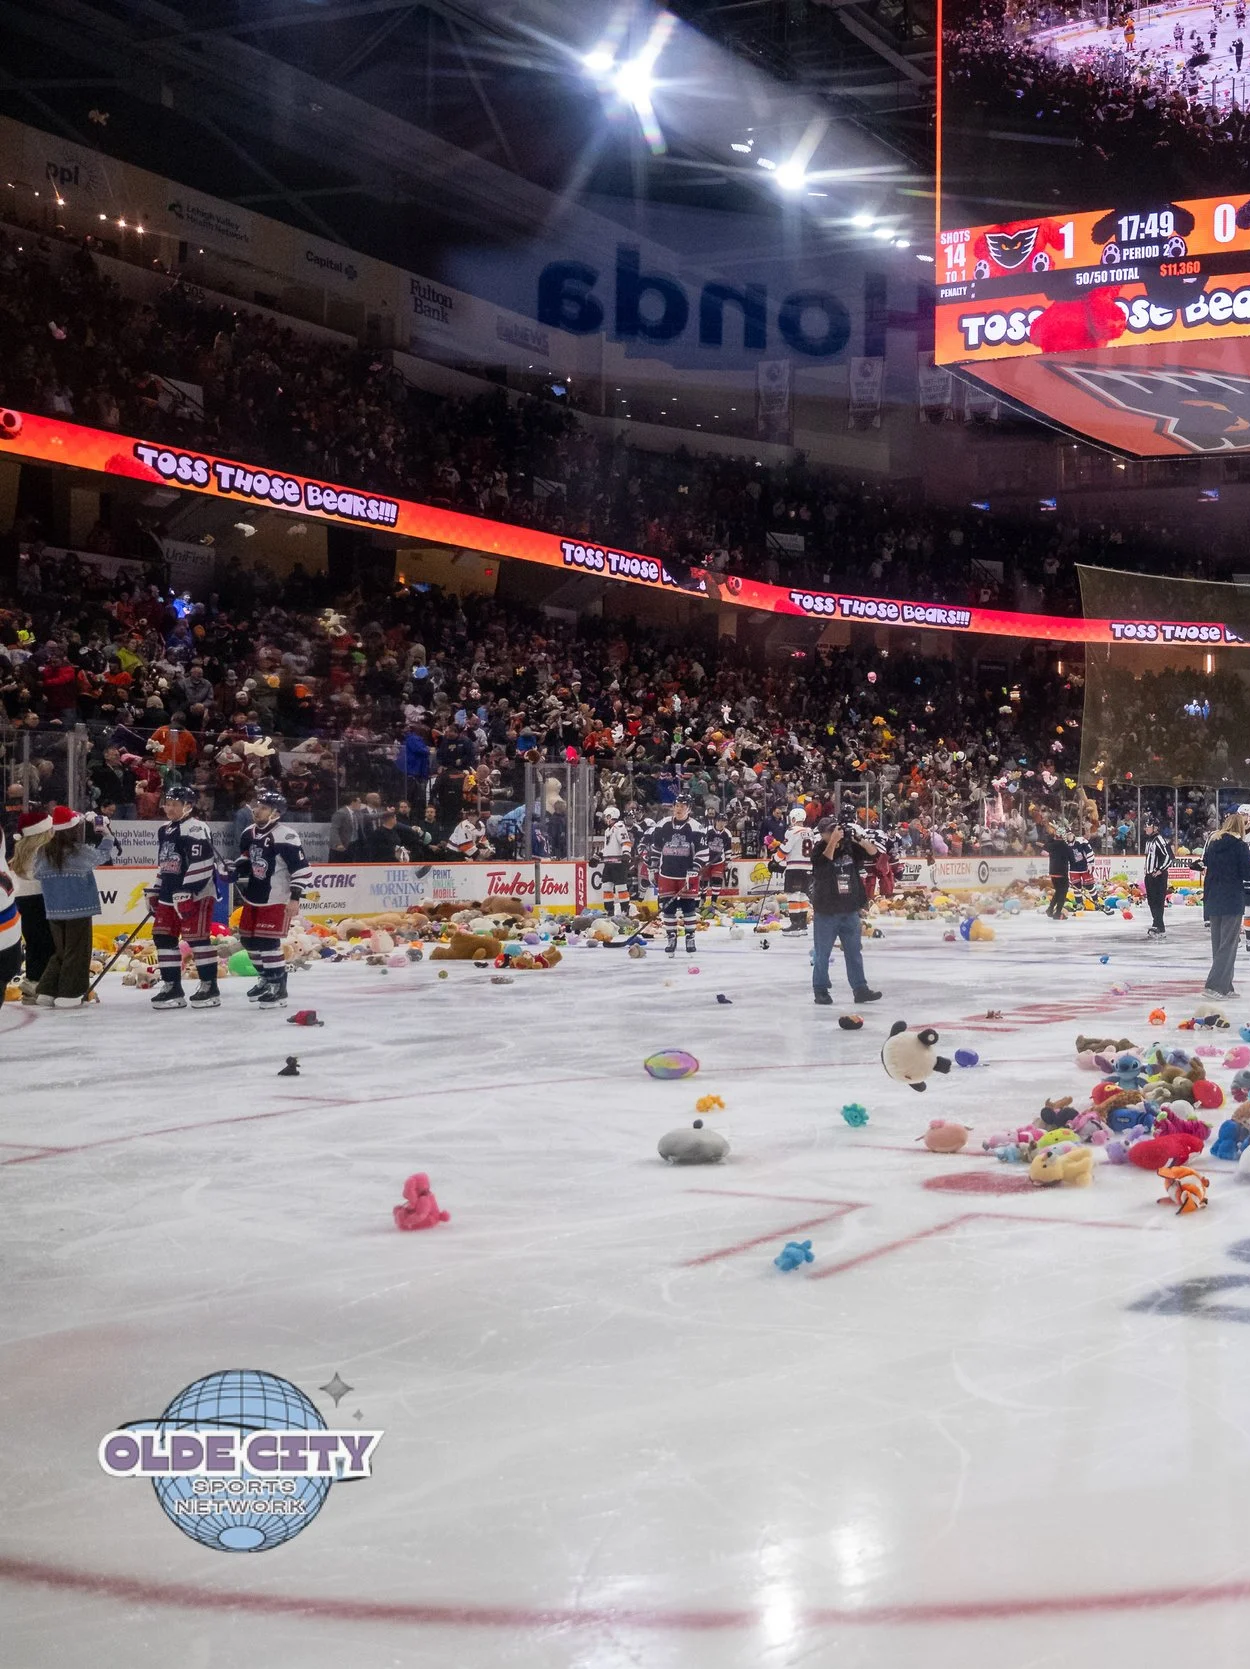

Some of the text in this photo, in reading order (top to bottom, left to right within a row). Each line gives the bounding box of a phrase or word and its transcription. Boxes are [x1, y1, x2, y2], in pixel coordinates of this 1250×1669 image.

[1118, 211, 1174, 242] 17:49
[1214, 203, 1236, 243] 0
[940, 230, 970, 245] SHOTS
[1059, 221, 1074, 259] 1
[944, 244, 966, 269] 14
[1122, 244, 1159, 260] PERIOD
[306, 251, 343, 273] Capital
[945, 270, 966, 283] TO 1
[1076, 261, 1200, 285] 50/50 TOTAL $11,360
[410, 278, 453, 309] Fulton
[940, 286, 967, 298] PENALTY
[413, 297, 449, 324] Bank
[111, 830, 156, 840] ehigh Valley
[263, 838, 270, 848] C
[132, 857, 156, 867] Valley
[384, 869, 409, 882] THE
[369, 883, 425, 896] MORNING
[577, 867, 585, 906] CCM
[383, 896, 410, 908] CALL
